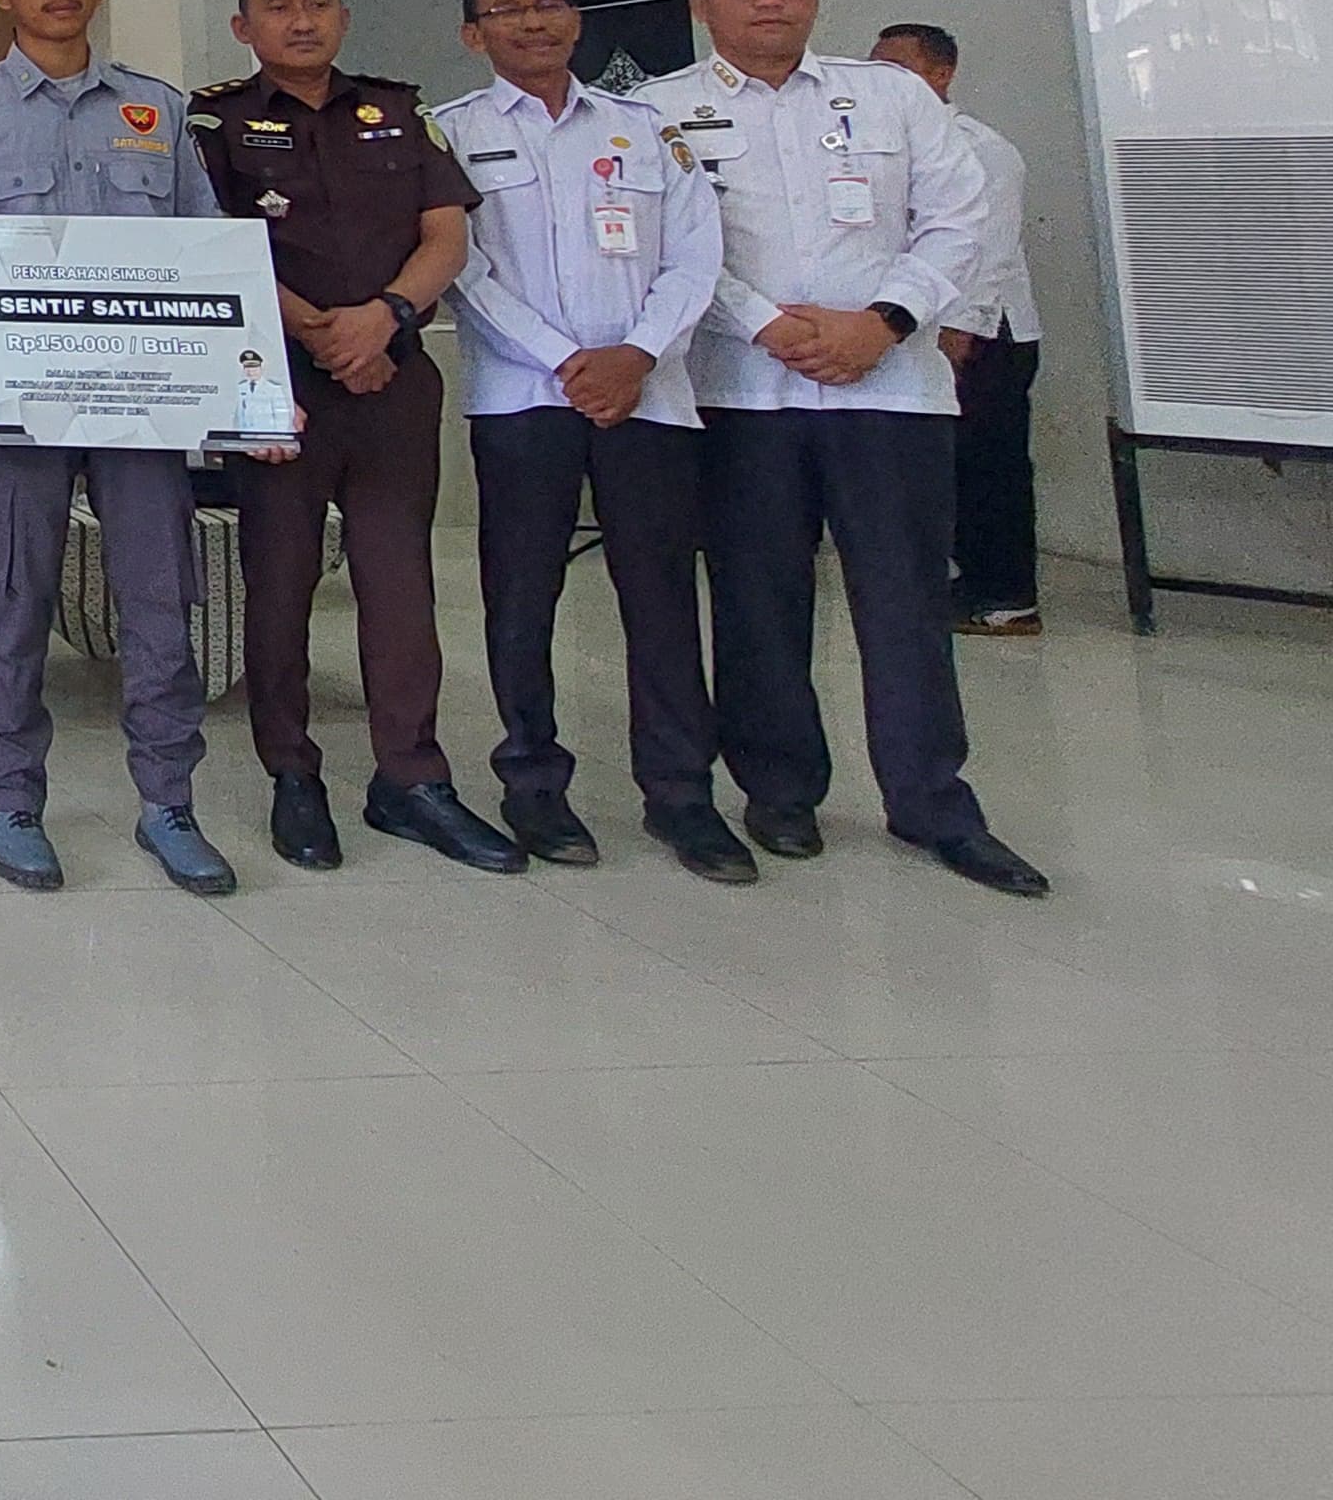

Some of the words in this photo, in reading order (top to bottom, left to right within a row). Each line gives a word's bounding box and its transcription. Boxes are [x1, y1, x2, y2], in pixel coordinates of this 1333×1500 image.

[12, 265, 108, 281] PENYERAHAN
[112, 267, 179, 283] SIMBOLIS
[91, 297, 233, 319] SATLINMAS
[6, 333, 124, 355] Rp150.000
[142, 337, 208, 355] Bulan
